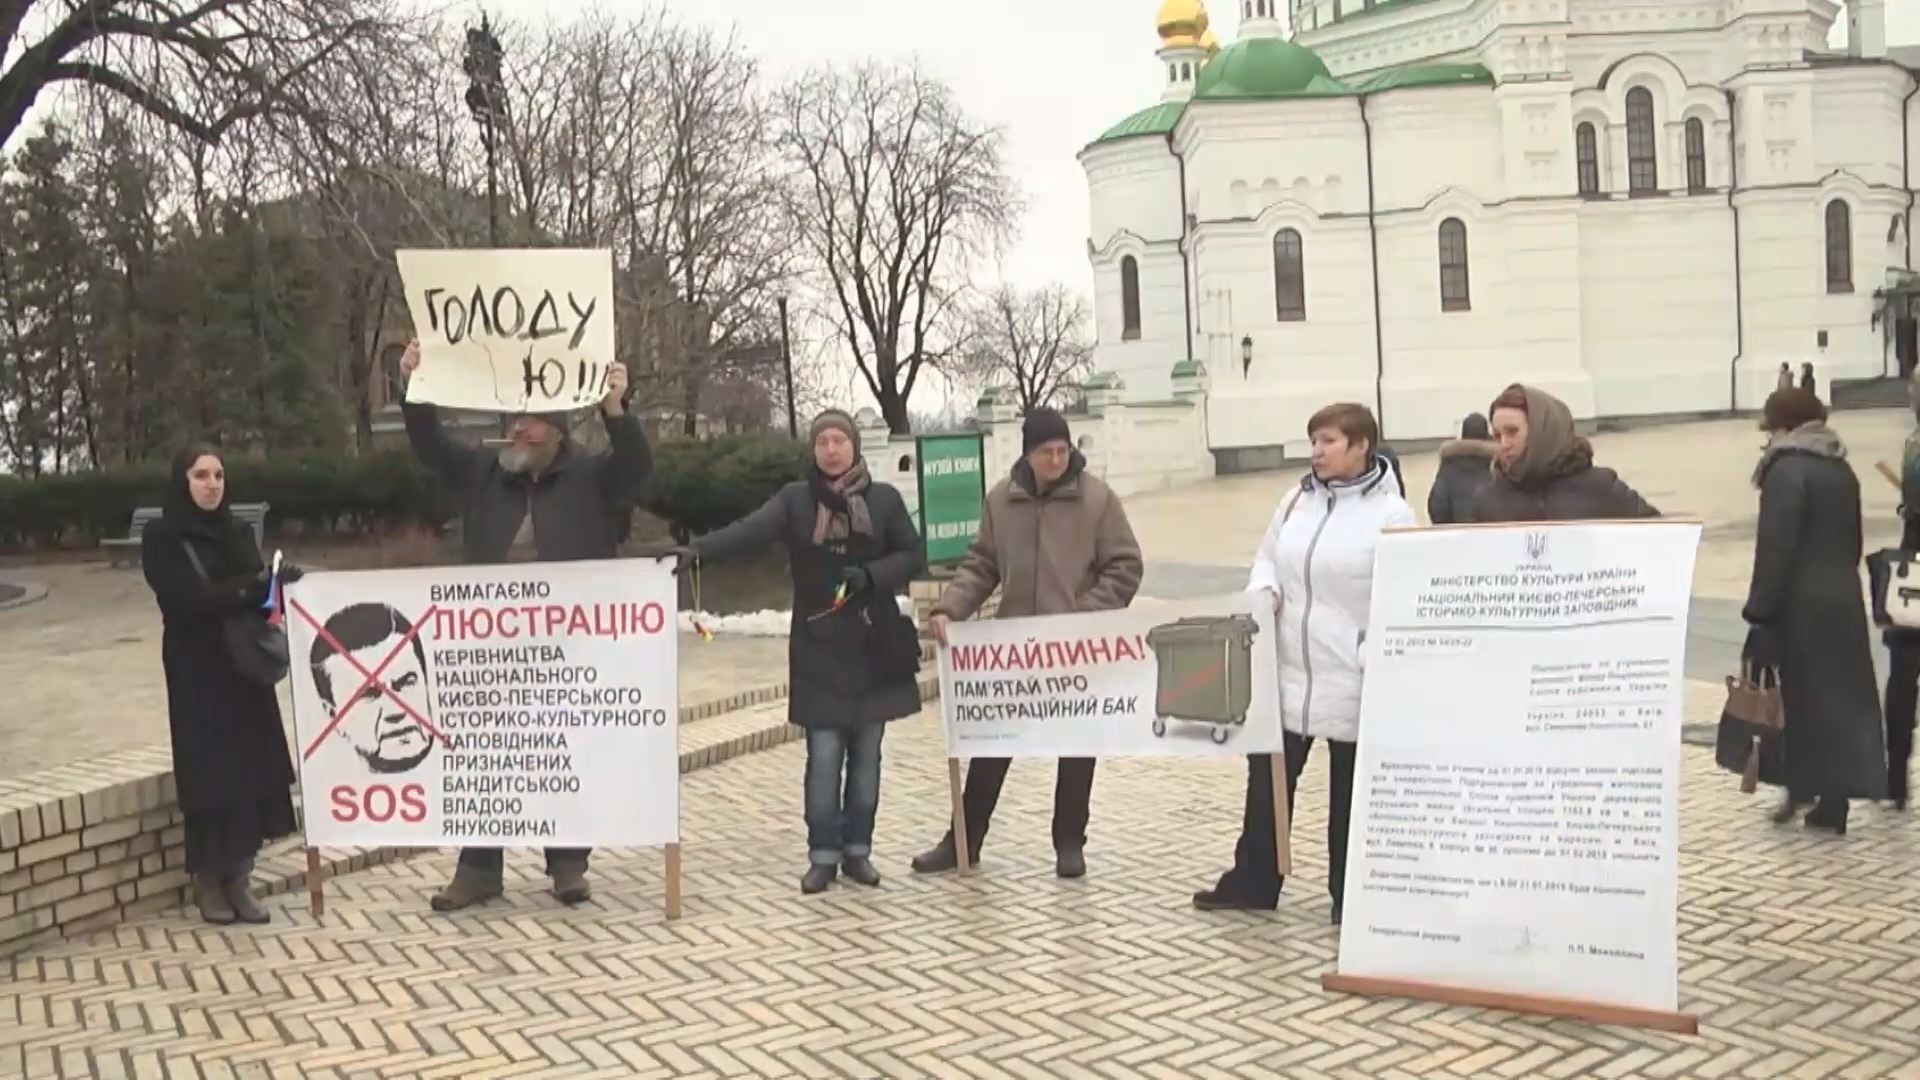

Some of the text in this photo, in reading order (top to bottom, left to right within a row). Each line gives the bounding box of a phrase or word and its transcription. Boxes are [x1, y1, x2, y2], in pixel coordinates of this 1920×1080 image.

[424, 284, 597, 351] ГОЛОДУ
[1430, 567, 1637, 588] МІНІСТЕРСТВО КУЛЬТУРИ УКРАЇНИ
[430, 580, 551, 602] ВИМАГАЄМО
[1418, 584, 1646, 606] НАЦІОНАЛЬНИЙ КИЄВО-ПЕЧЕРСЬКИЙ
[1416, 597, 1639, 619] ІСТОРИКО-КУЛЬТУРНИЙ ЗАПОВІДНИК
[432, 602, 665, 642] ЛЮСТРАЦІЮ
[433, 648, 566, 666] КЕРІВНИЦТВА
[951, 635, 1147, 673] МИХАЙЛИНА!
[435, 667, 598, 687] НАЦІОНАЛЬНОГО
[954, 674, 1088, 699] ПАМ'ЯТАЙ ПРО
[438, 688, 642, 707] КИЄВО-ПЕЧЕРСЬКОГО
[440, 709, 666, 729] ІСТОРИКО-КУЛЬТУРНОГО
[956, 695, 1138, 722] ЛЮСТРАЦІЙНИЙ БАК
[442, 732, 568, 751] ЗАПОВІДНИКА
[443, 755, 572, 772] ПРИЗНАЧЕНИХ
[443, 776, 580, 795] БАНДИТСЬКОЮ
[330, 783, 428, 823] SOS
[443, 797, 523, 817] ВЛАДОЮ
[443, 819, 556, 837] ЯНУКОВИЧА!
